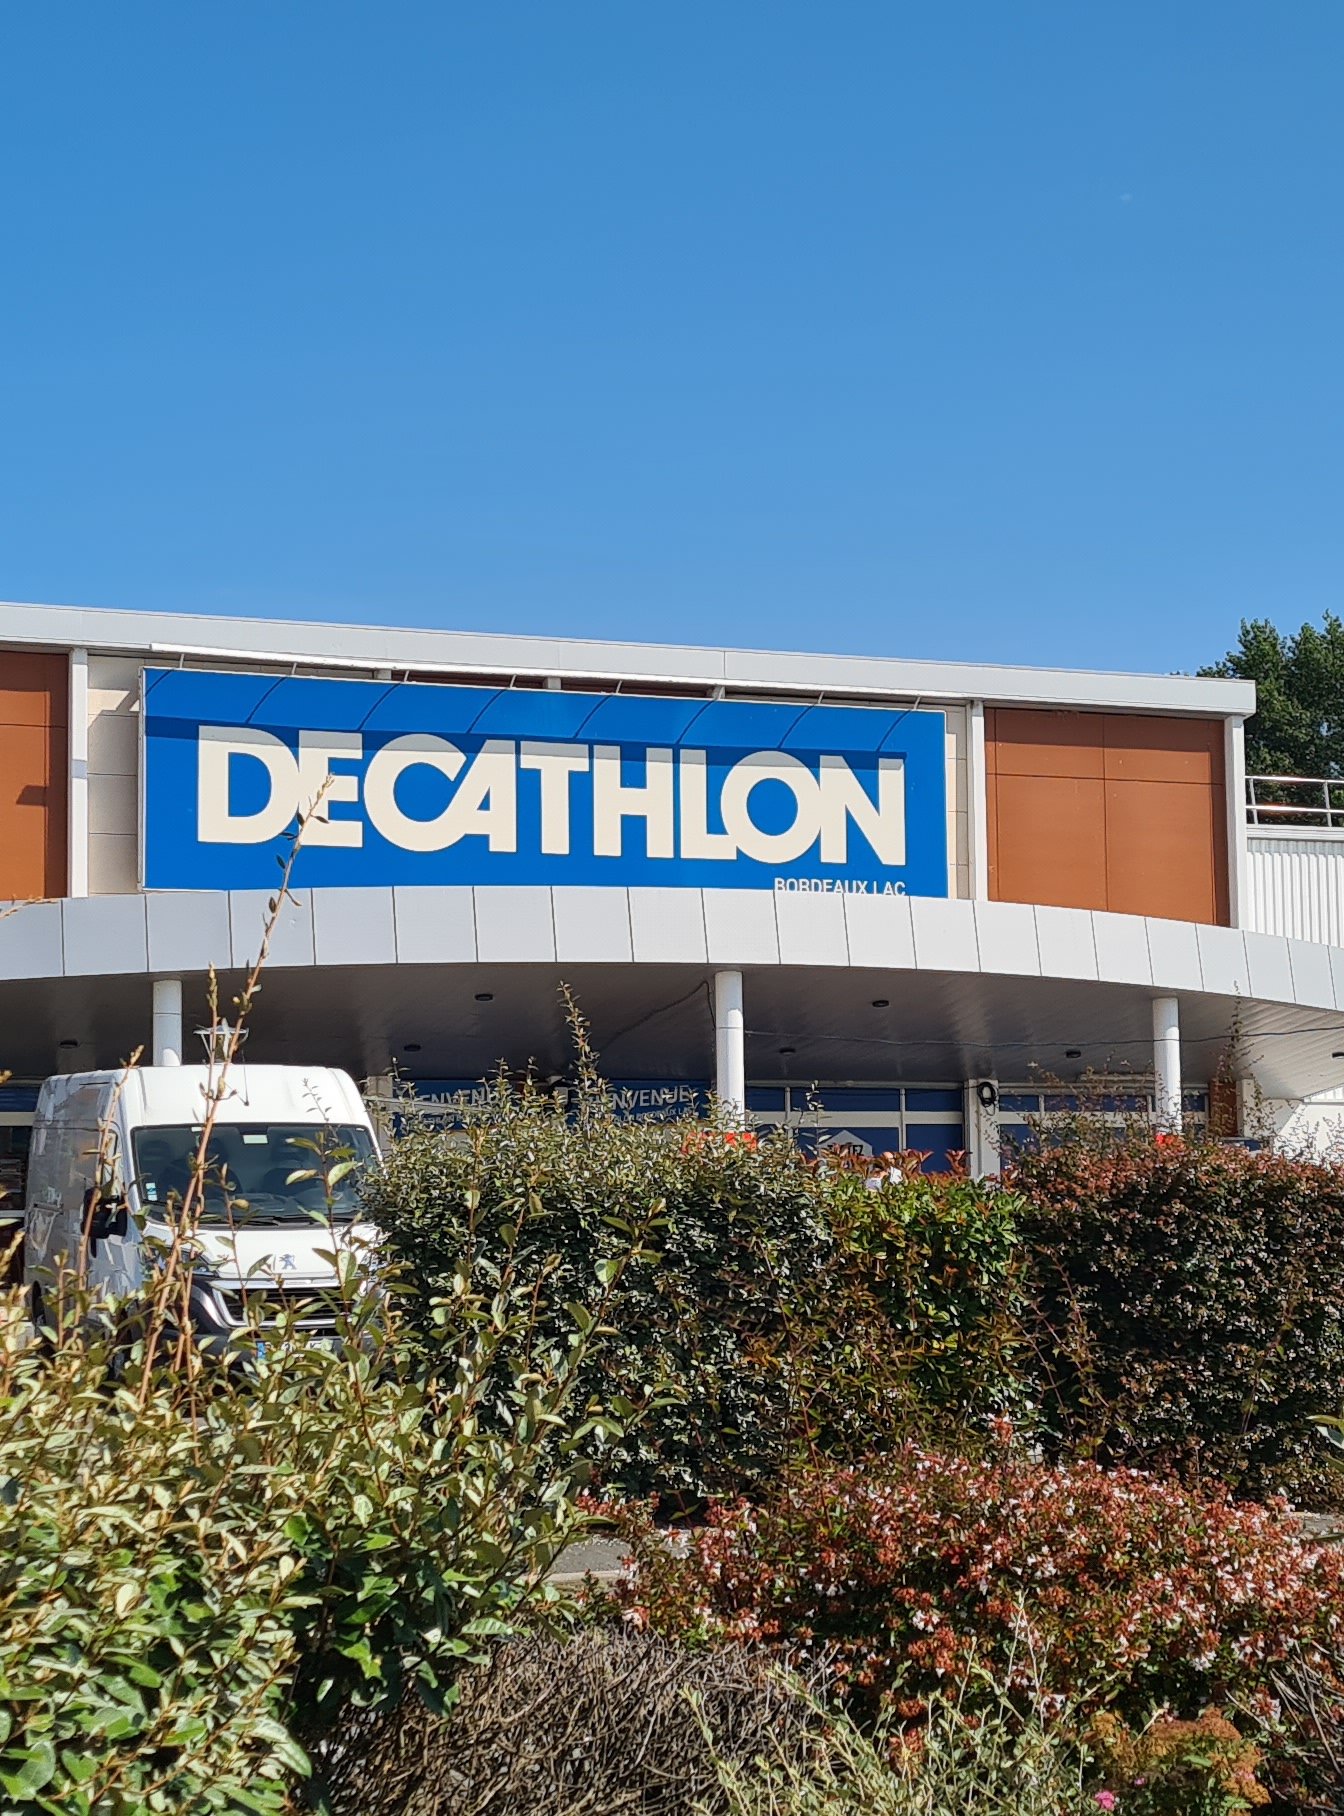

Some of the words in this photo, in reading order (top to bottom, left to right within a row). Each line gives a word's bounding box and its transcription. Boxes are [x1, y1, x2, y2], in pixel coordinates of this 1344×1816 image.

[198, 725, 907, 866] DECATHLON
[774, 877, 868, 894] BORDEAUX
[873, 881, 906, 896] LAC
